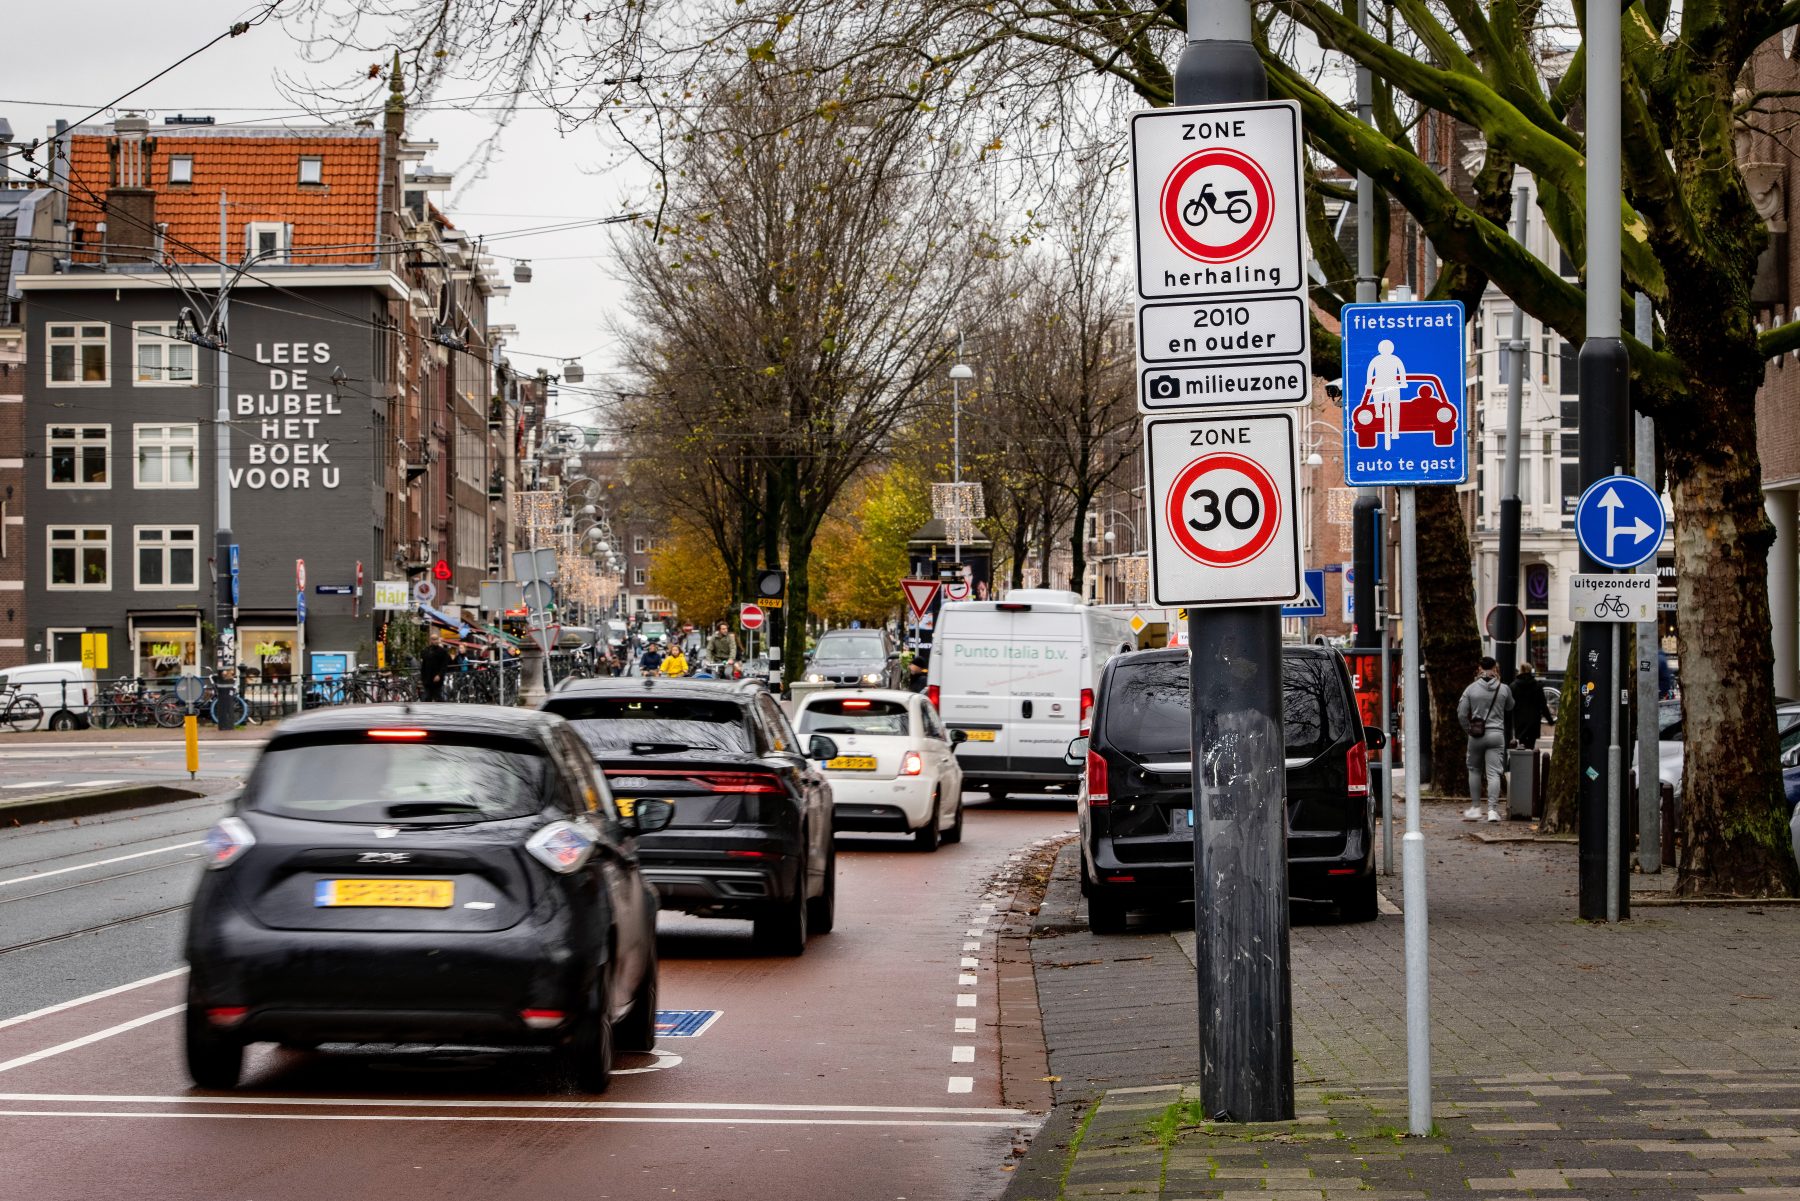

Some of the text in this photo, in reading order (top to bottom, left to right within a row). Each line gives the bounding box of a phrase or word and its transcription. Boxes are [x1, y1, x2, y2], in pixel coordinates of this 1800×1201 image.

[1182, 121, 1246, 140] ZONE
[1164, 266, 1281, 287] herhaling
[1193, 307, 1250, 328] 2010
[1353, 313, 1453, 330] fietsstraat
[1168, 331, 1276, 353] en ouder
[256, 342, 331, 364] LEES
[269, 369, 309, 390] DE
[1186, 375, 1299, 395] milieuzone
[236, 394, 342, 415] BIJBEL
[261, 418, 320, 439] HET
[1190, 427, 1251, 446] ZONE
[249, 443, 331, 465] BOEK
[1356, 457, 1456, 474] auto te gast
[229, 467, 340, 489] VOOR U
[1188, 487, 1260, 532] 30
[1574, 579, 1651, 591] uitgezonderd
[954, 644, 1069, 660] Punto Italia b.v.
